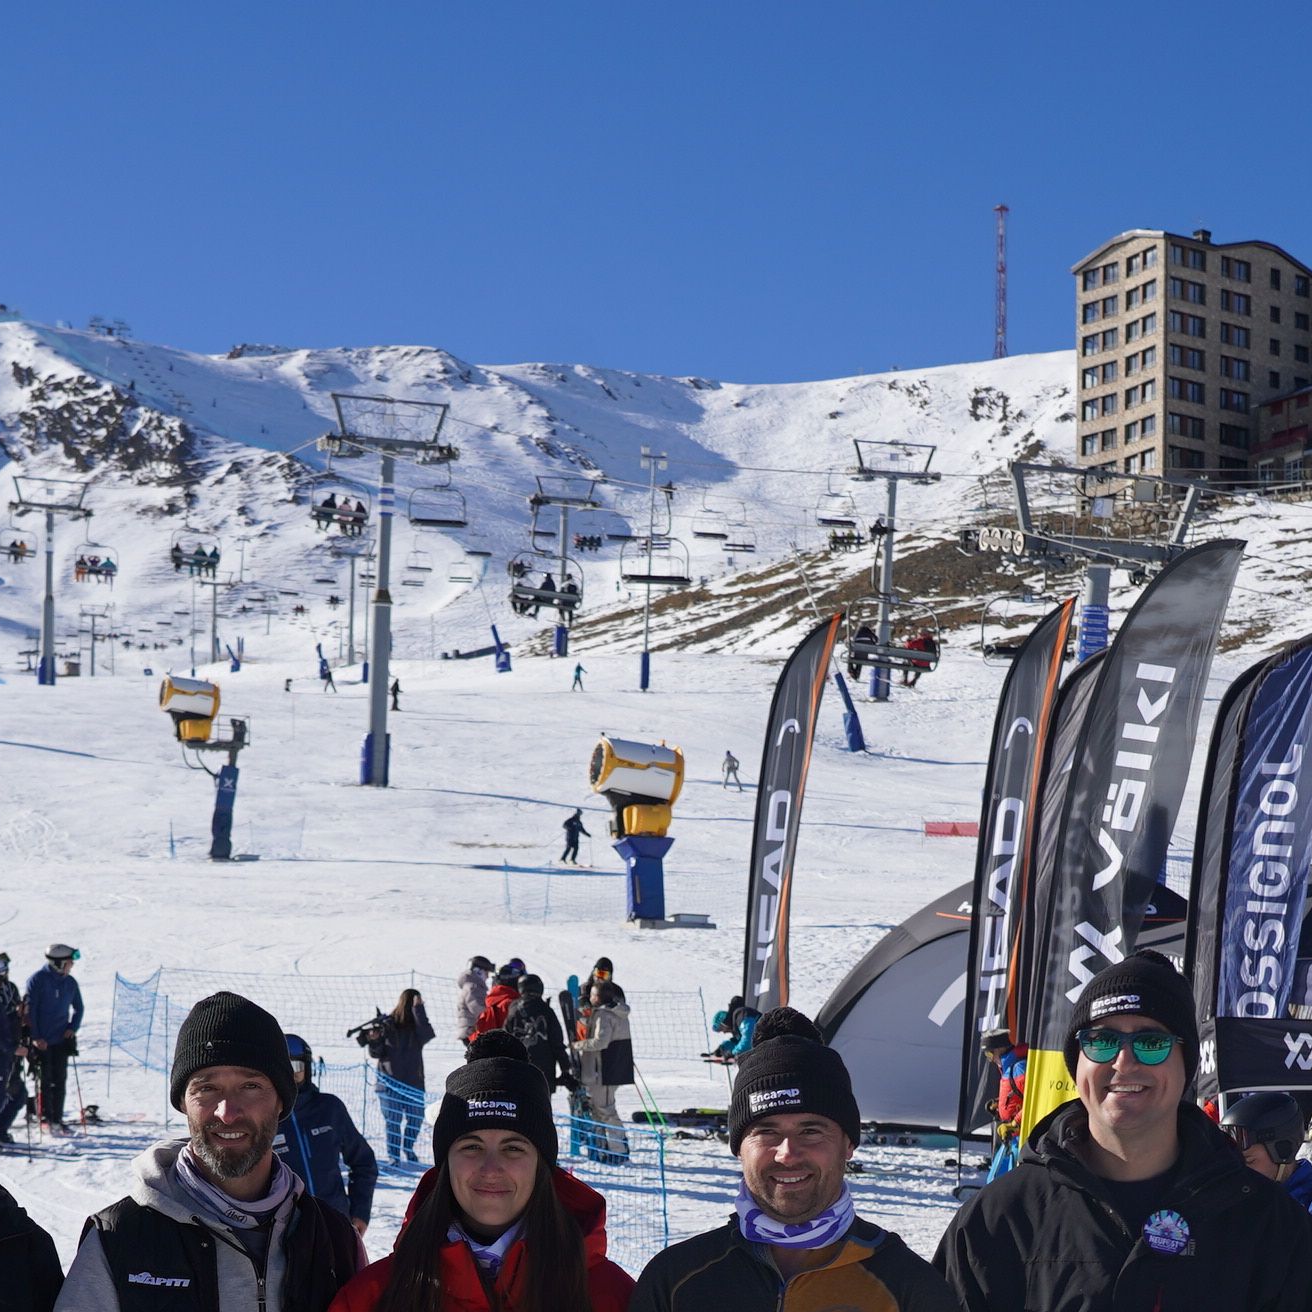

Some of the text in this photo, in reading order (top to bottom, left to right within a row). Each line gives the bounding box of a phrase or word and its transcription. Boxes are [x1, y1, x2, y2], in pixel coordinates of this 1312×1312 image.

[754, 789, 791, 997] HEAD
[978, 797, 1024, 1032] HEAD
[1237, 744, 1303, 1018] OSSIGNOL
[467, 1099, 517, 1111] Encamp
[750, 1088, 800, 1104] Encamp
